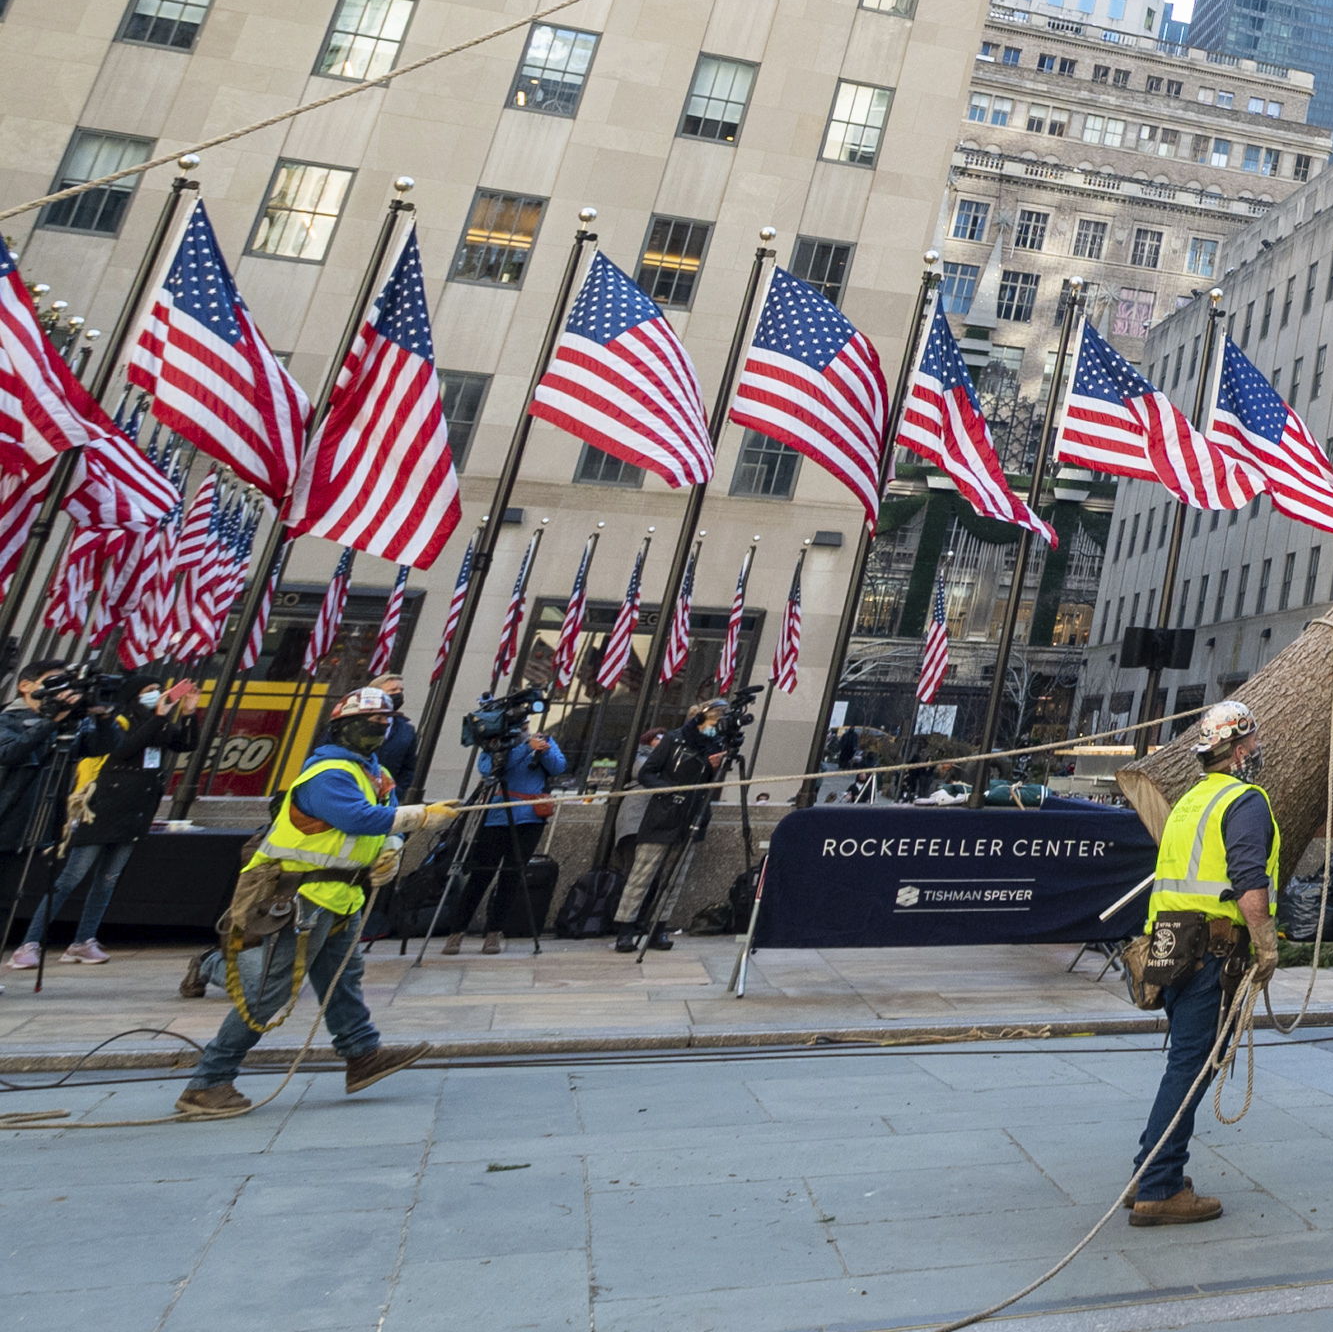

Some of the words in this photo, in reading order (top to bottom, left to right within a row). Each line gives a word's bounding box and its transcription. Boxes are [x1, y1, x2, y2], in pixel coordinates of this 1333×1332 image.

[822, 838, 1003, 857] ROCKEFELLER
[1012, 839, 1106, 857] CENTER
[923, 890, 982, 902] TISHMAN
[983, 889, 1033, 901] SPEYER
